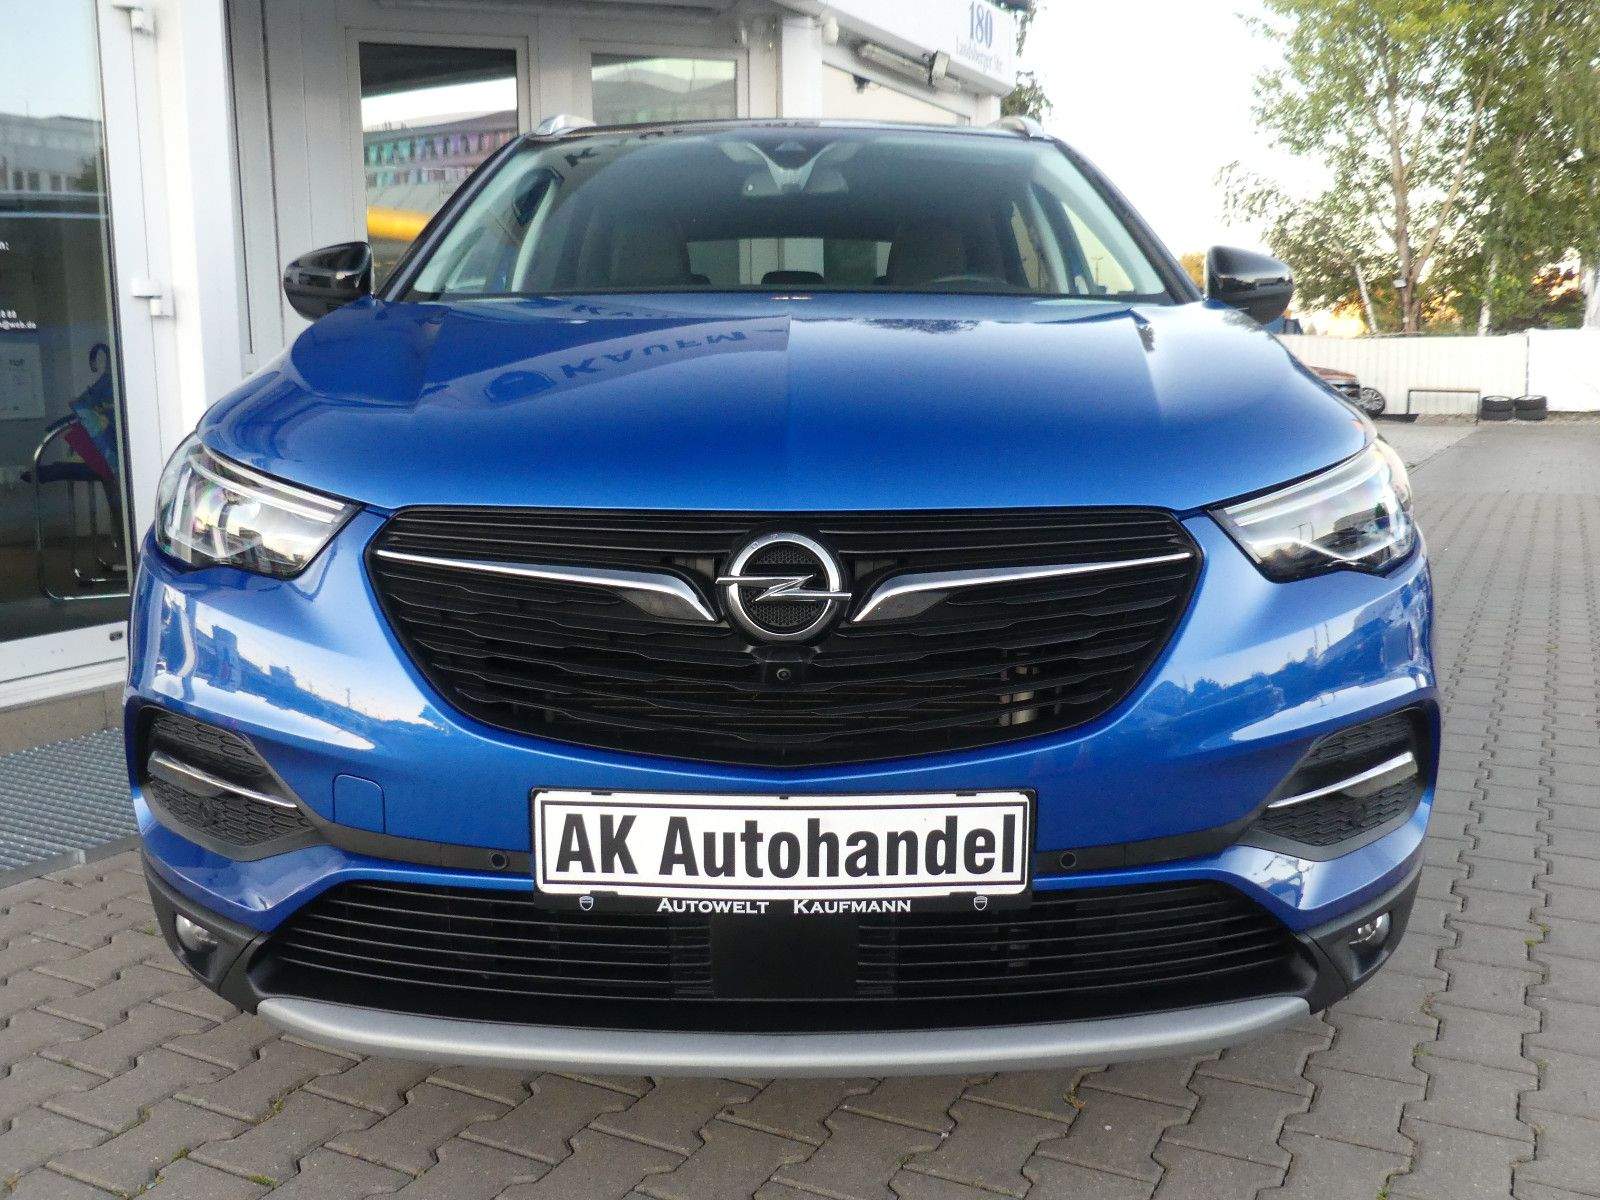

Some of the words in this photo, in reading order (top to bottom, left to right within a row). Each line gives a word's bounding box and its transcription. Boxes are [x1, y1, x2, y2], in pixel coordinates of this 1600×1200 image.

[969, 1, 993, 48] 180
[555, 813, 639, 875] AK
[658, 813, 1016, 879] Autohandel
[656, 897, 770, 915] AUTOWELT
[793, 899, 912, 914] KAUFMANN
